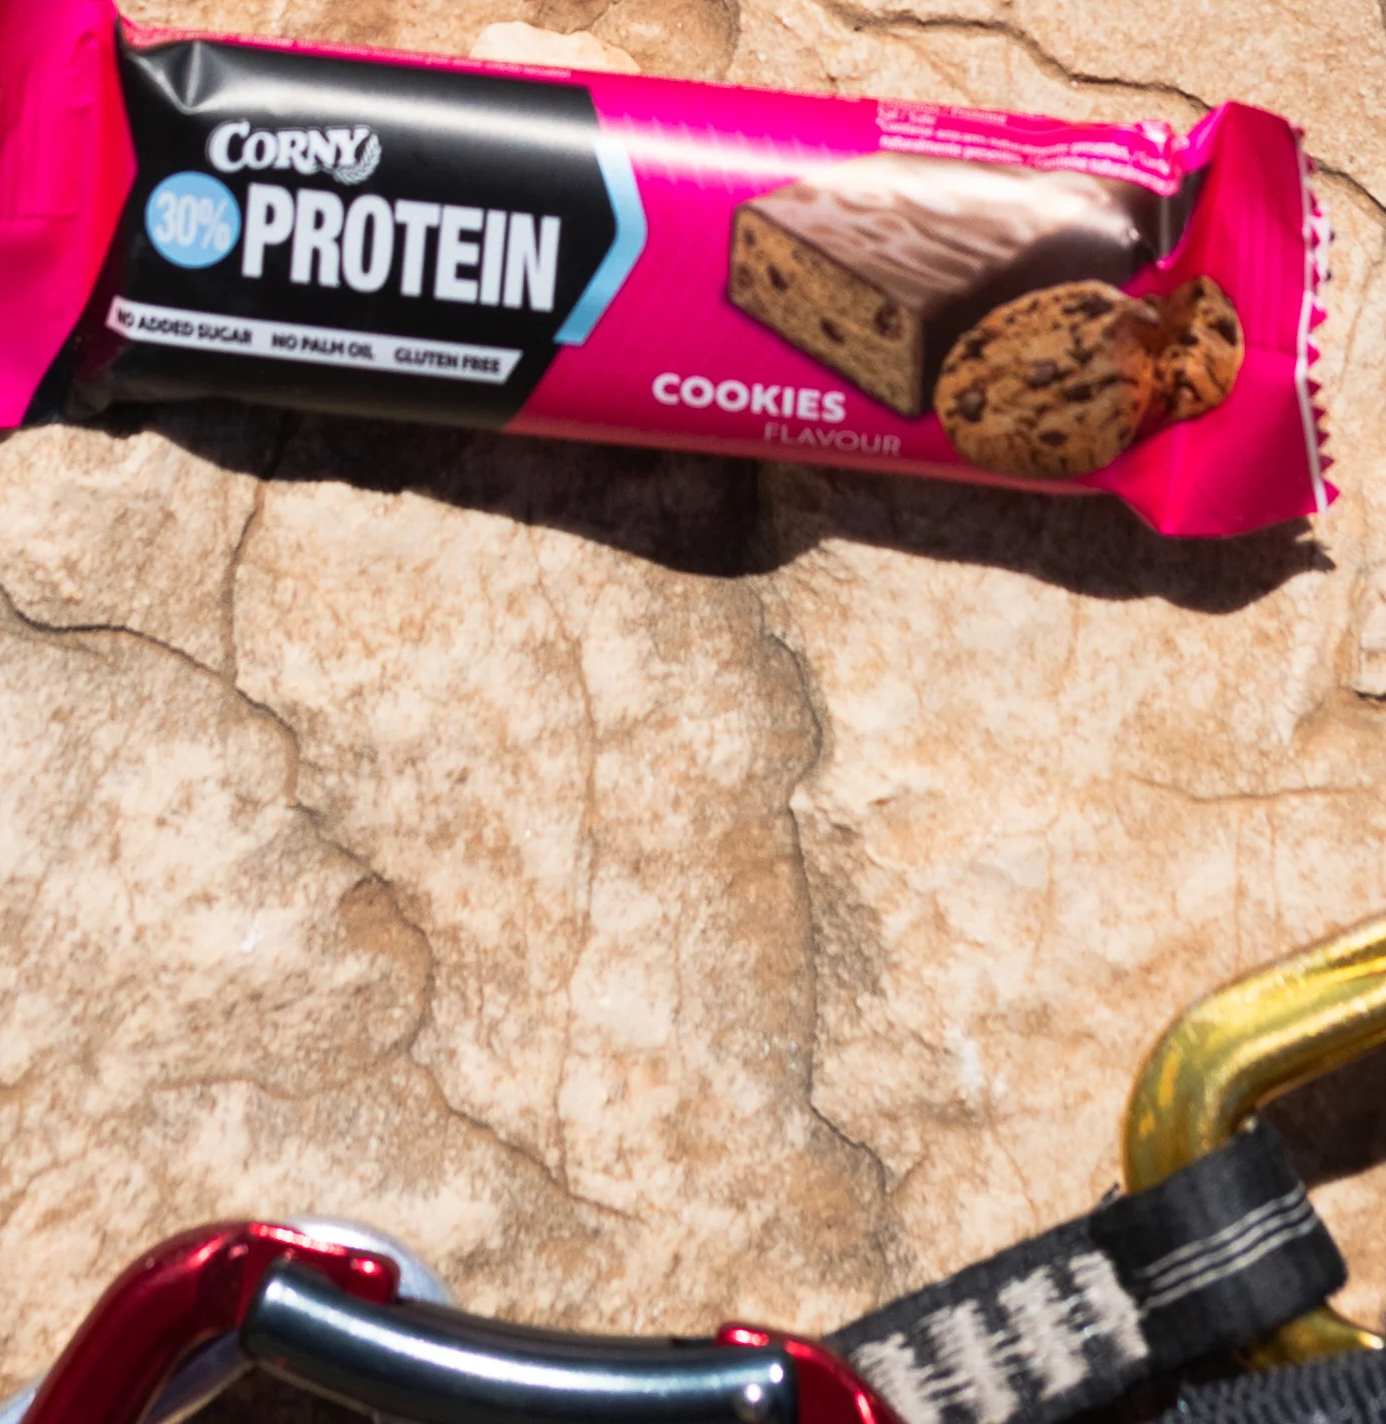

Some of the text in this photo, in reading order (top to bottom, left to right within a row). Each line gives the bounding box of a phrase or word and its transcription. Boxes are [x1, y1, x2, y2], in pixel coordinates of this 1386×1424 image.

[207, 119, 372, 174] CORNY
[155, 181, 562, 314] 30% PROTEIN
[138, 315, 194, 338] ADDED
[197, 322, 254, 346] SUGAR
[271, 330, 298, 351] NO
[300, 335, 347, 357] PALM
[348, 340, 376, 361] OIL
[393, 347, 459, 370] GLUTEN
[461, 355, 503, 376] FREE
[651, 371, 847, 424] COOKIES
[763, 420, 902, 458] FLAVOUR
